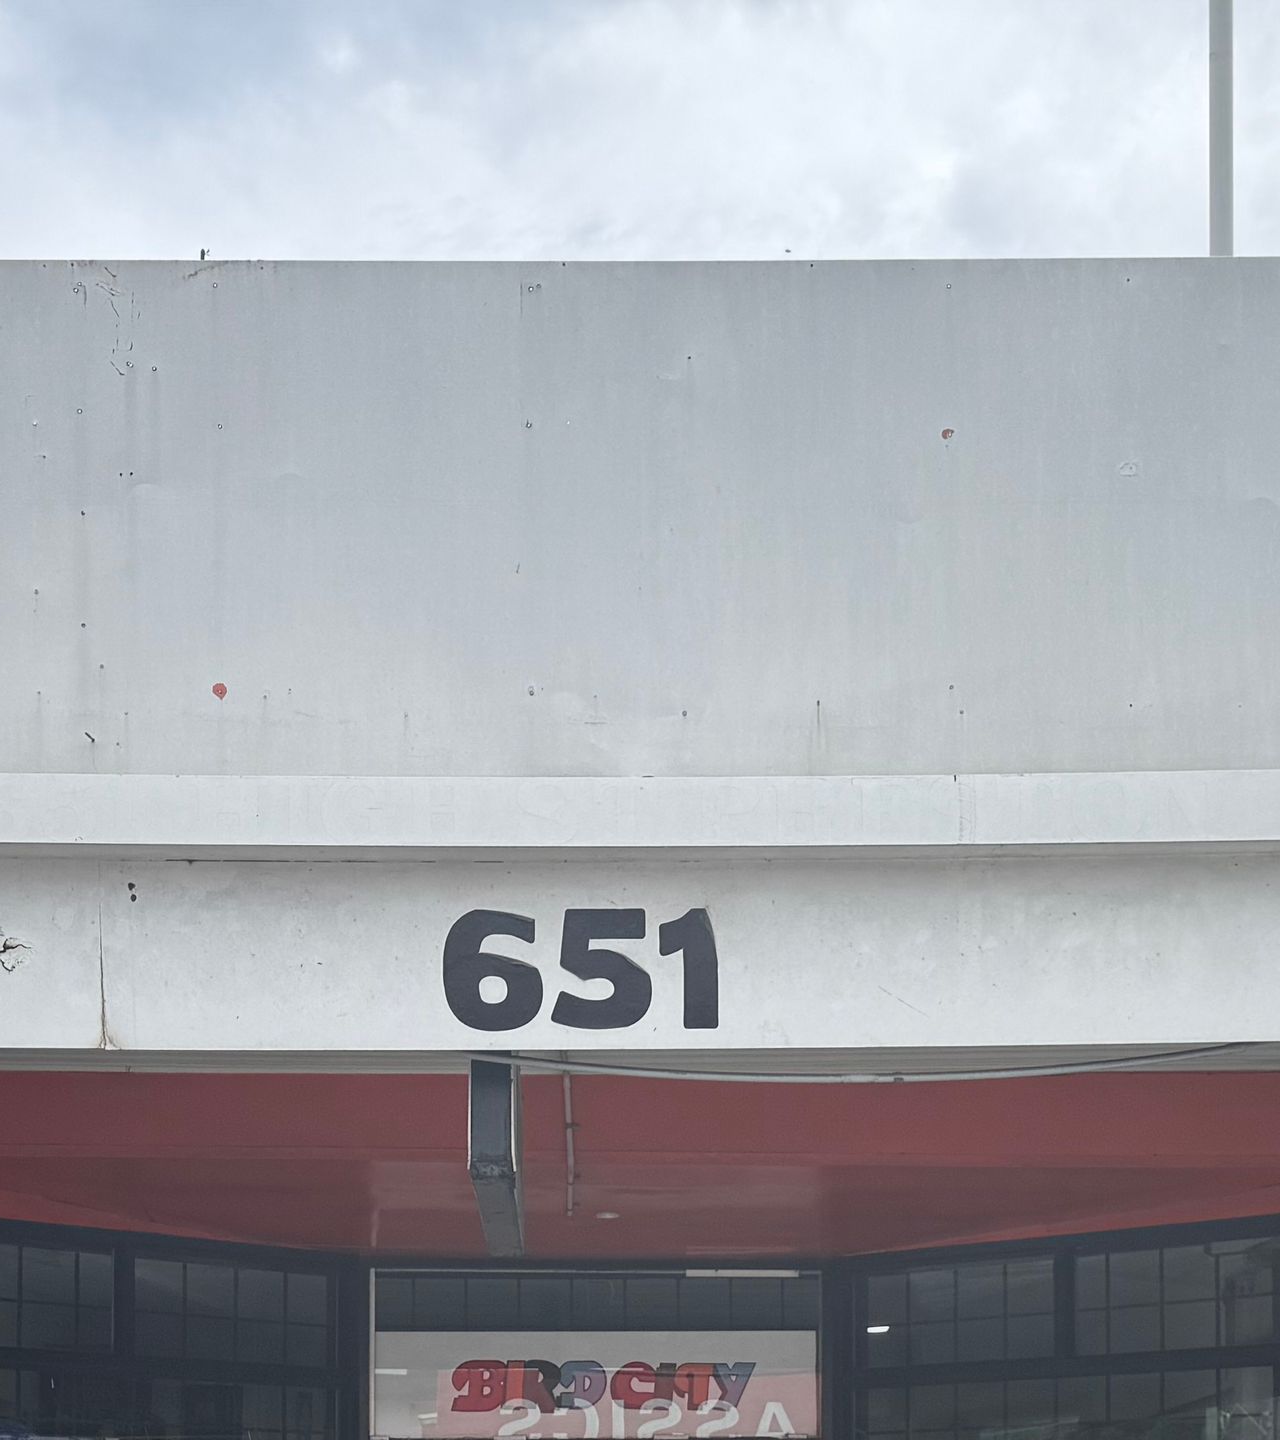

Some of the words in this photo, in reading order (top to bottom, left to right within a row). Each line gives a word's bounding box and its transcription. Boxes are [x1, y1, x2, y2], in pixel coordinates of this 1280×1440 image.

[442, 907, 719, 1032] 651
[451, 1359, 608, 1414] BIRD
[609, 1360, 757, 1412] CITY
